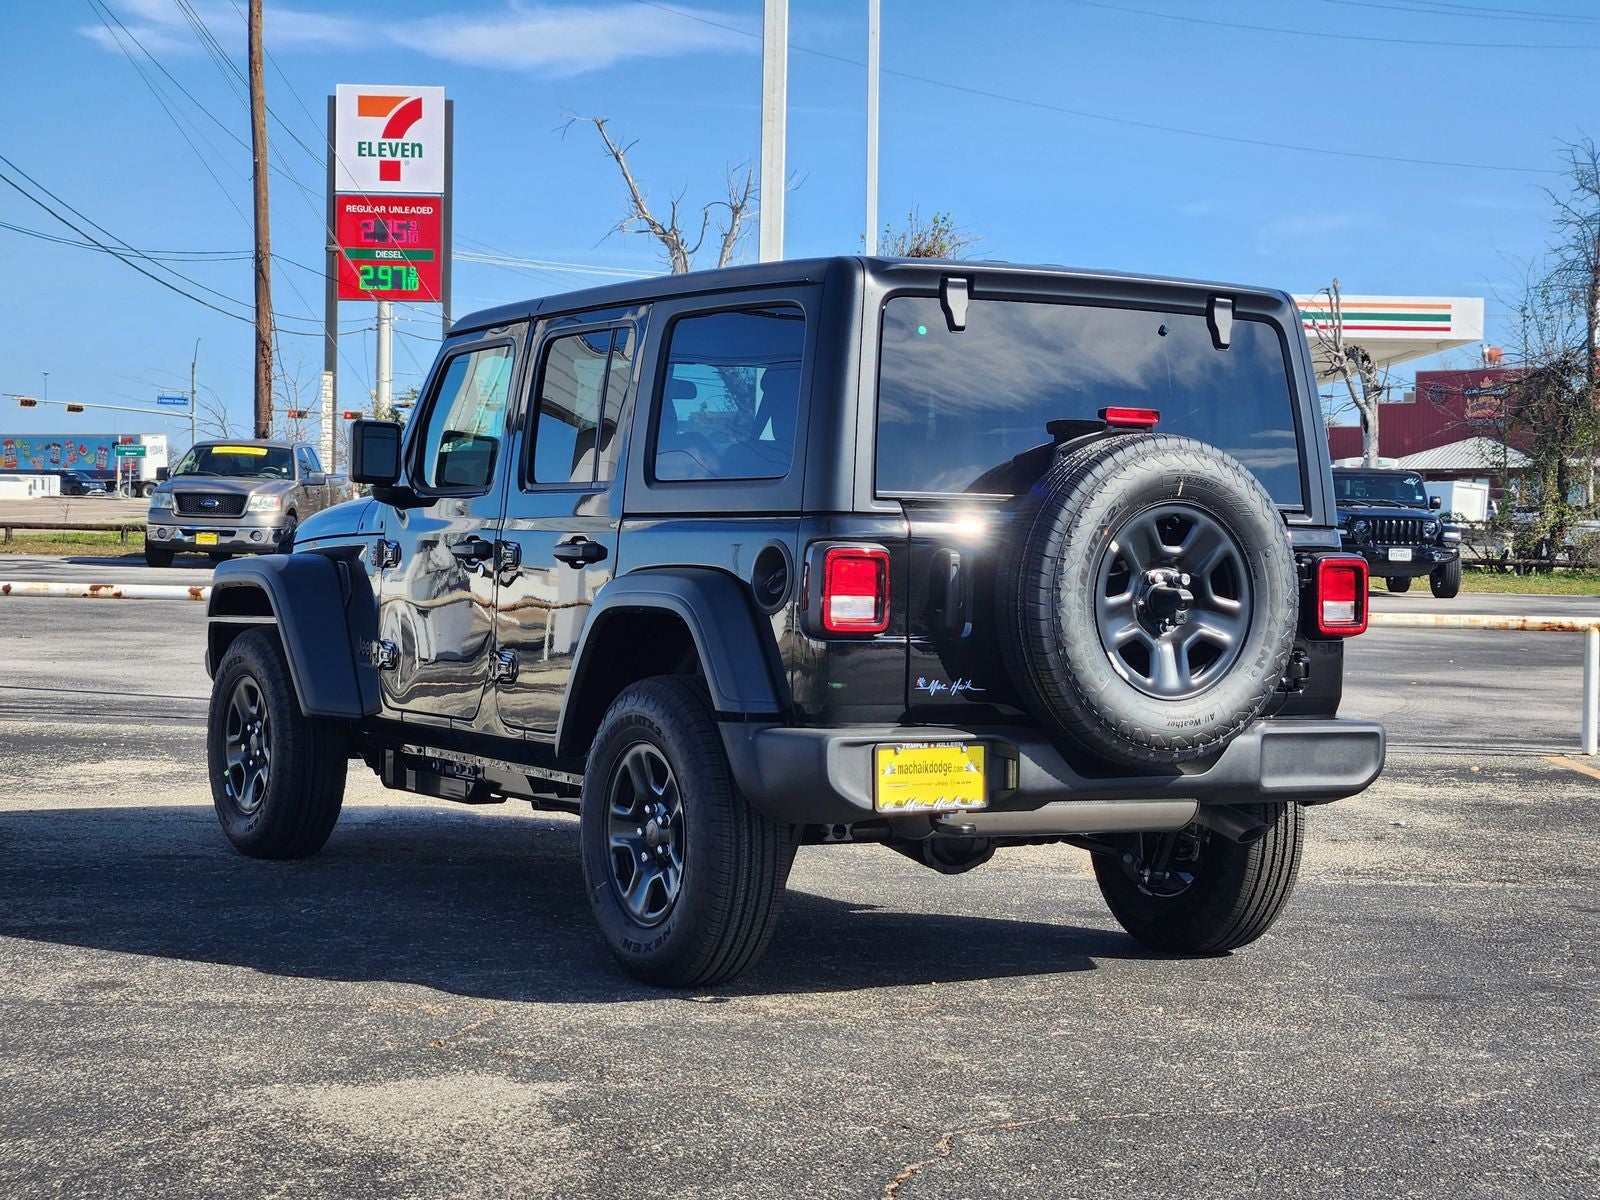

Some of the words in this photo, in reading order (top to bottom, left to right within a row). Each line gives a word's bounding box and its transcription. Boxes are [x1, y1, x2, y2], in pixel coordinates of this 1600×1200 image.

[358, 95, 422, 181] 7
[346, 204, 386, 214] REGULAR
[389, 205, 433, 215] UNLEADED
[375, 250, 403, 259] DIESEL
[359, 265, 407, 290] 2.97
[1166, 712, 1215, 728] All-Weather
